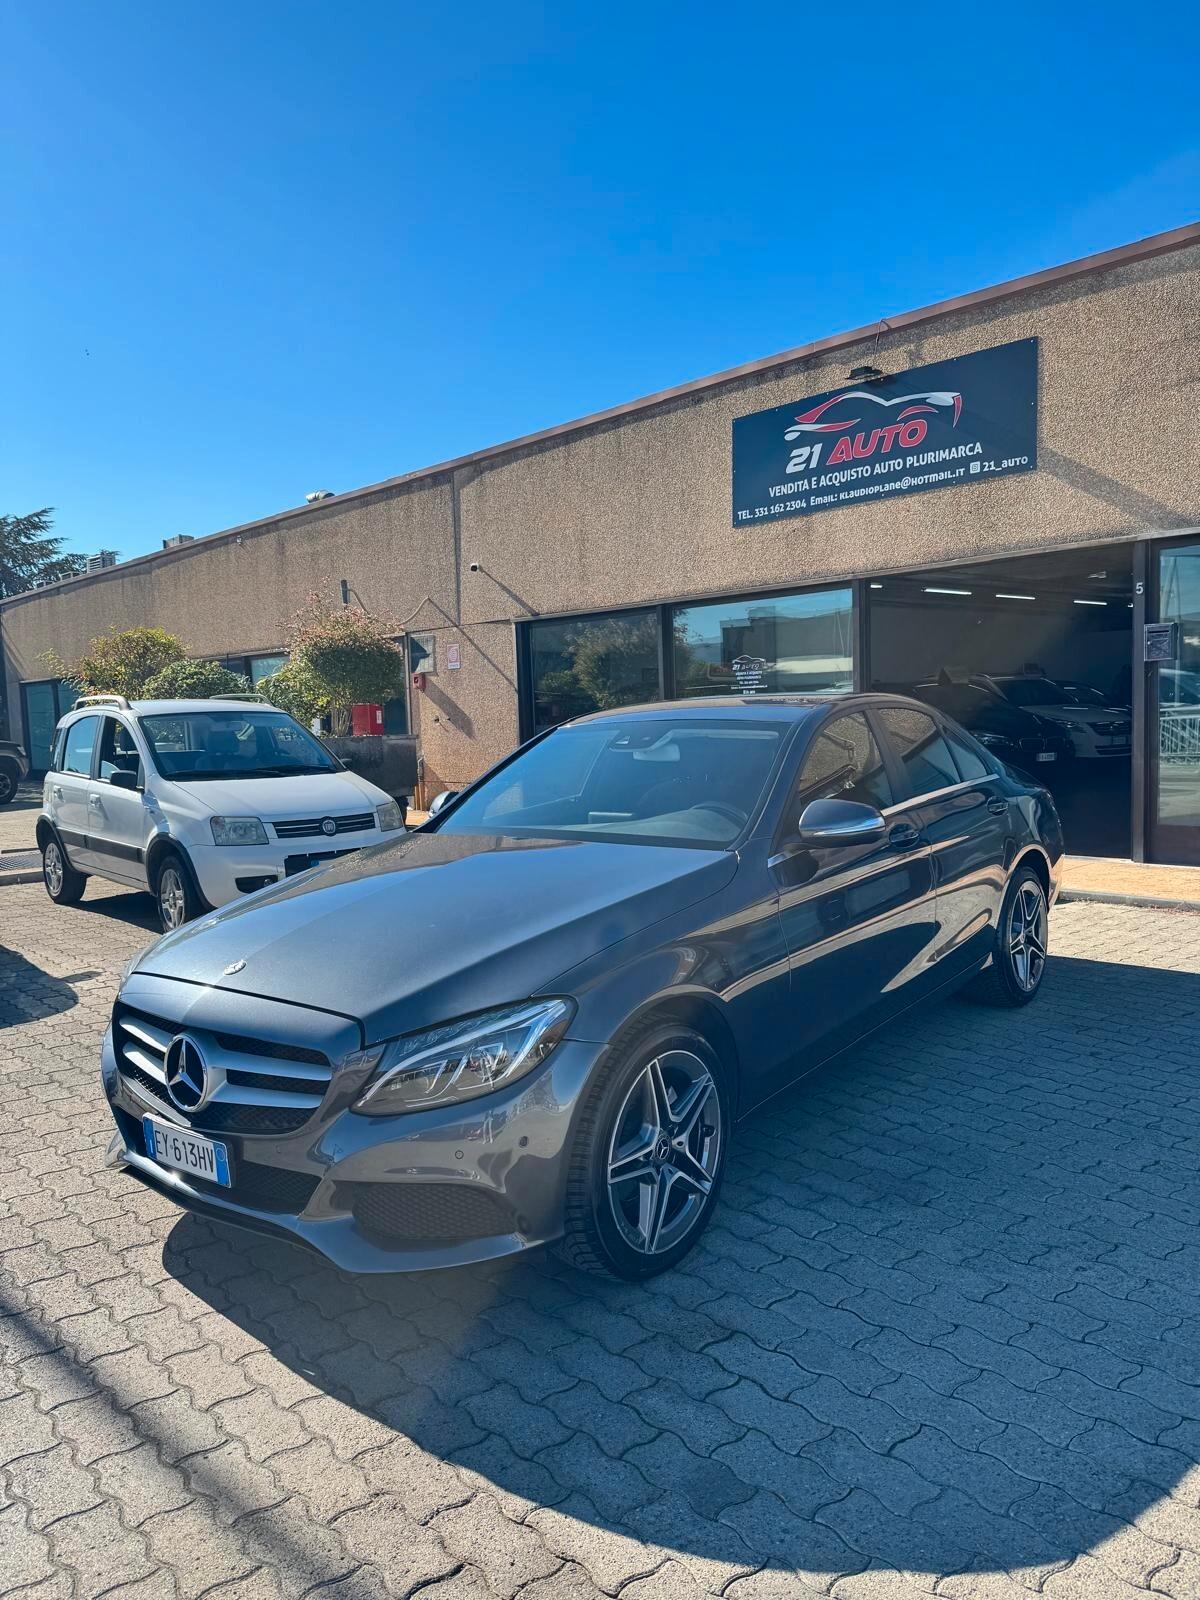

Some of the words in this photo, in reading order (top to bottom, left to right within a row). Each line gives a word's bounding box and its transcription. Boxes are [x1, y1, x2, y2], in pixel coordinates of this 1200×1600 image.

[785, 443, 823, 475] 21
[826, 419, 928, 466] AUTO
[768, 479, 810, 498] VENDITA
[811, 477, 818, 489] E
[819, 467, 871, 487] ACQUISTO
[873, 458, 904, 475] AUTO
[906, 442, 983, 468] PLURIMARCA
[737, 510, 753, 521] TEL.
[754, 507, 769, 518] 331
[770, 503, 785, 514] 162
[786, 499, 807, 511] 2304
[1136, 582, 1143, 594] 5
